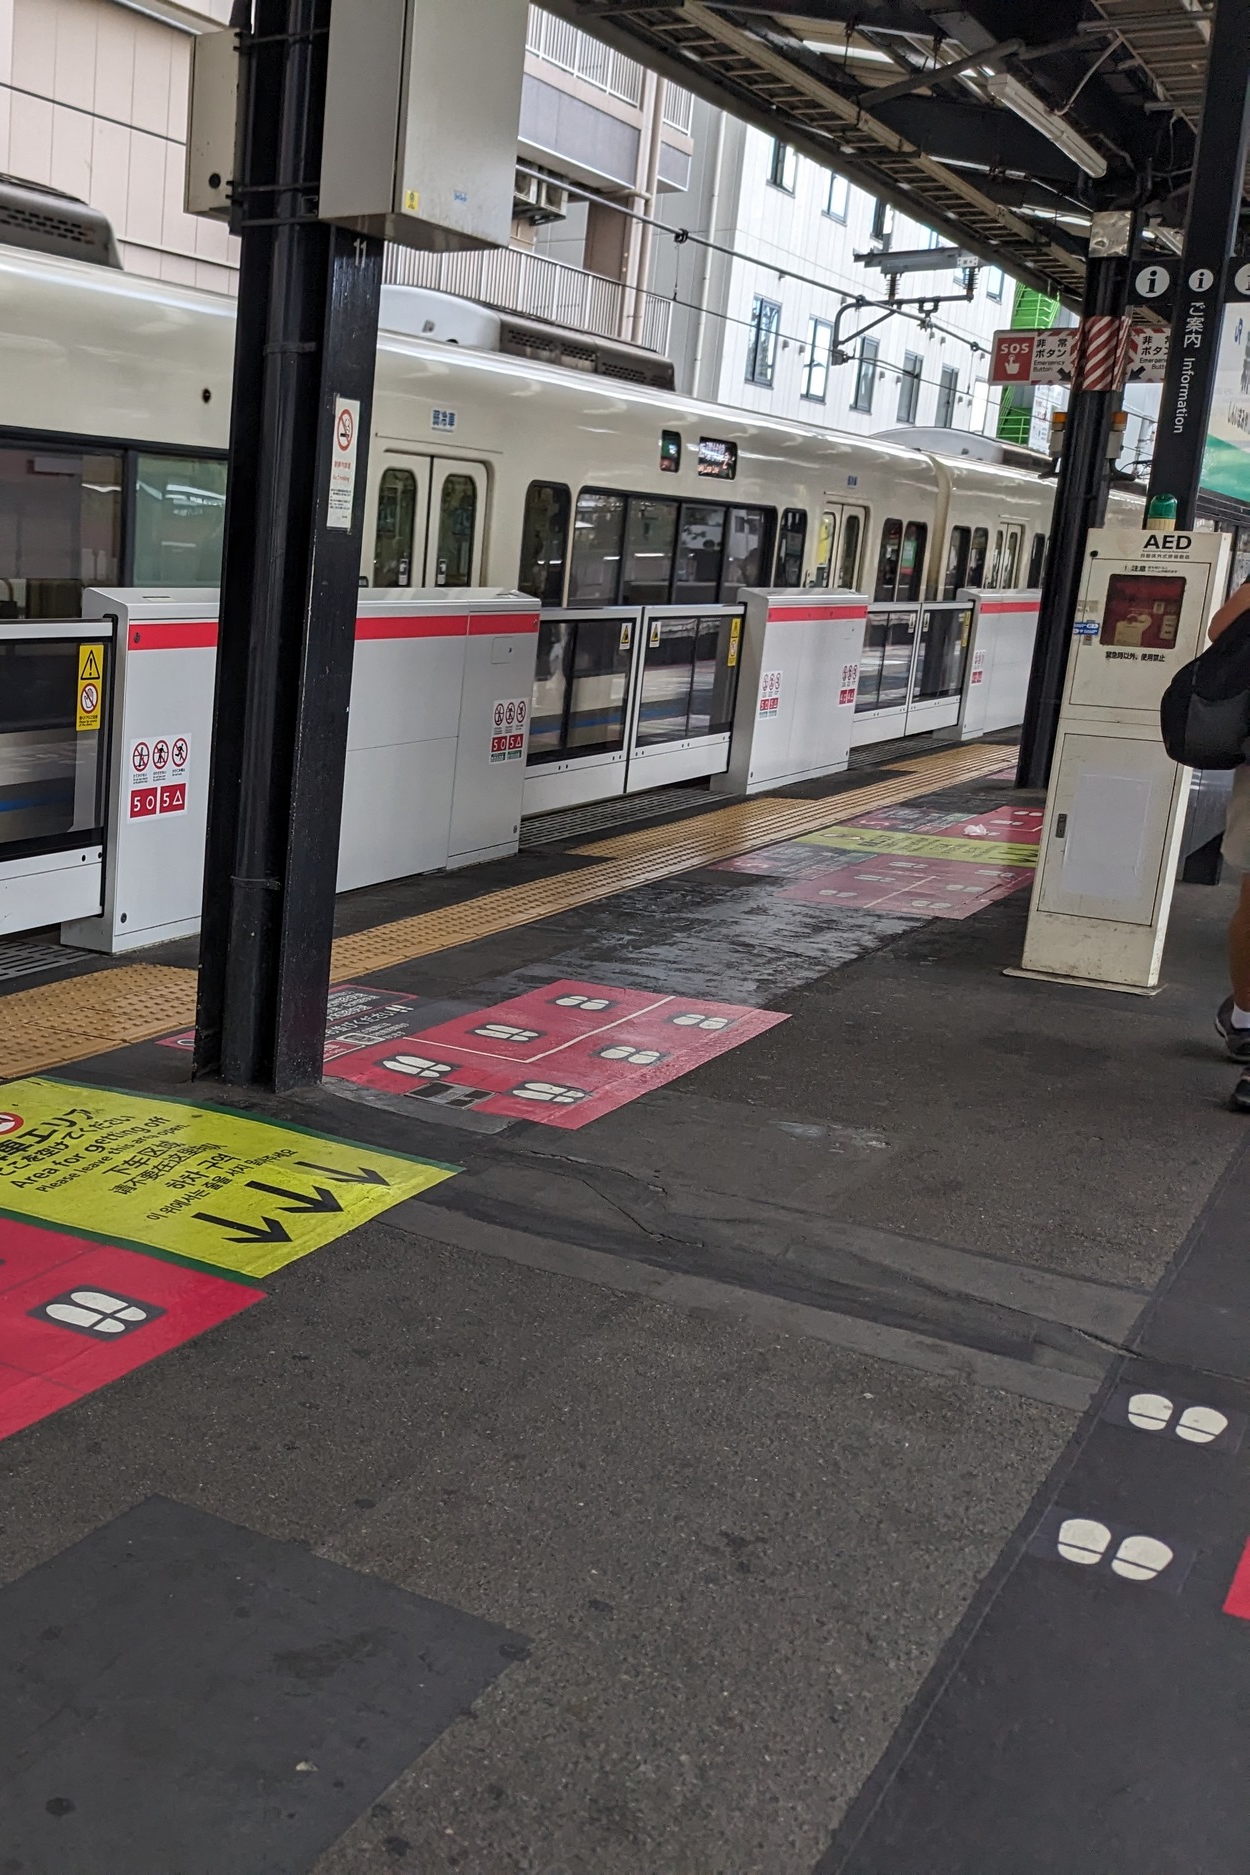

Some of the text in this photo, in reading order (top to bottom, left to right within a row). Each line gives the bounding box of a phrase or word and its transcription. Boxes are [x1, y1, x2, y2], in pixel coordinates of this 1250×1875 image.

[1184, 302, 1205, 348] ご案内
[1000, 343, 1030, 354] SOS
[1035, 349, 1067, 358] ボタン
[1174, 358, 1195, 433] Information
[1143, 534, 1192, 550] AED
[133, 797, 141, 811] 5
[163, 792, 170, 807] 5
[10, 1115, 171, 1188] Area for getting off
[35, 1172, 80, 1192] Please
[73, 1155, 113, 1173] leave
[108, 1143, 135, 1154] this
[165, 1153, 242, 1190] 하차 구역
[146, 1211, 168, 1221] 이
[162, 1188, 210, 1214] 위에서는
[202, 1175, 234, 1191] 줄을
[224, 1163, 254, 1177] 서지
